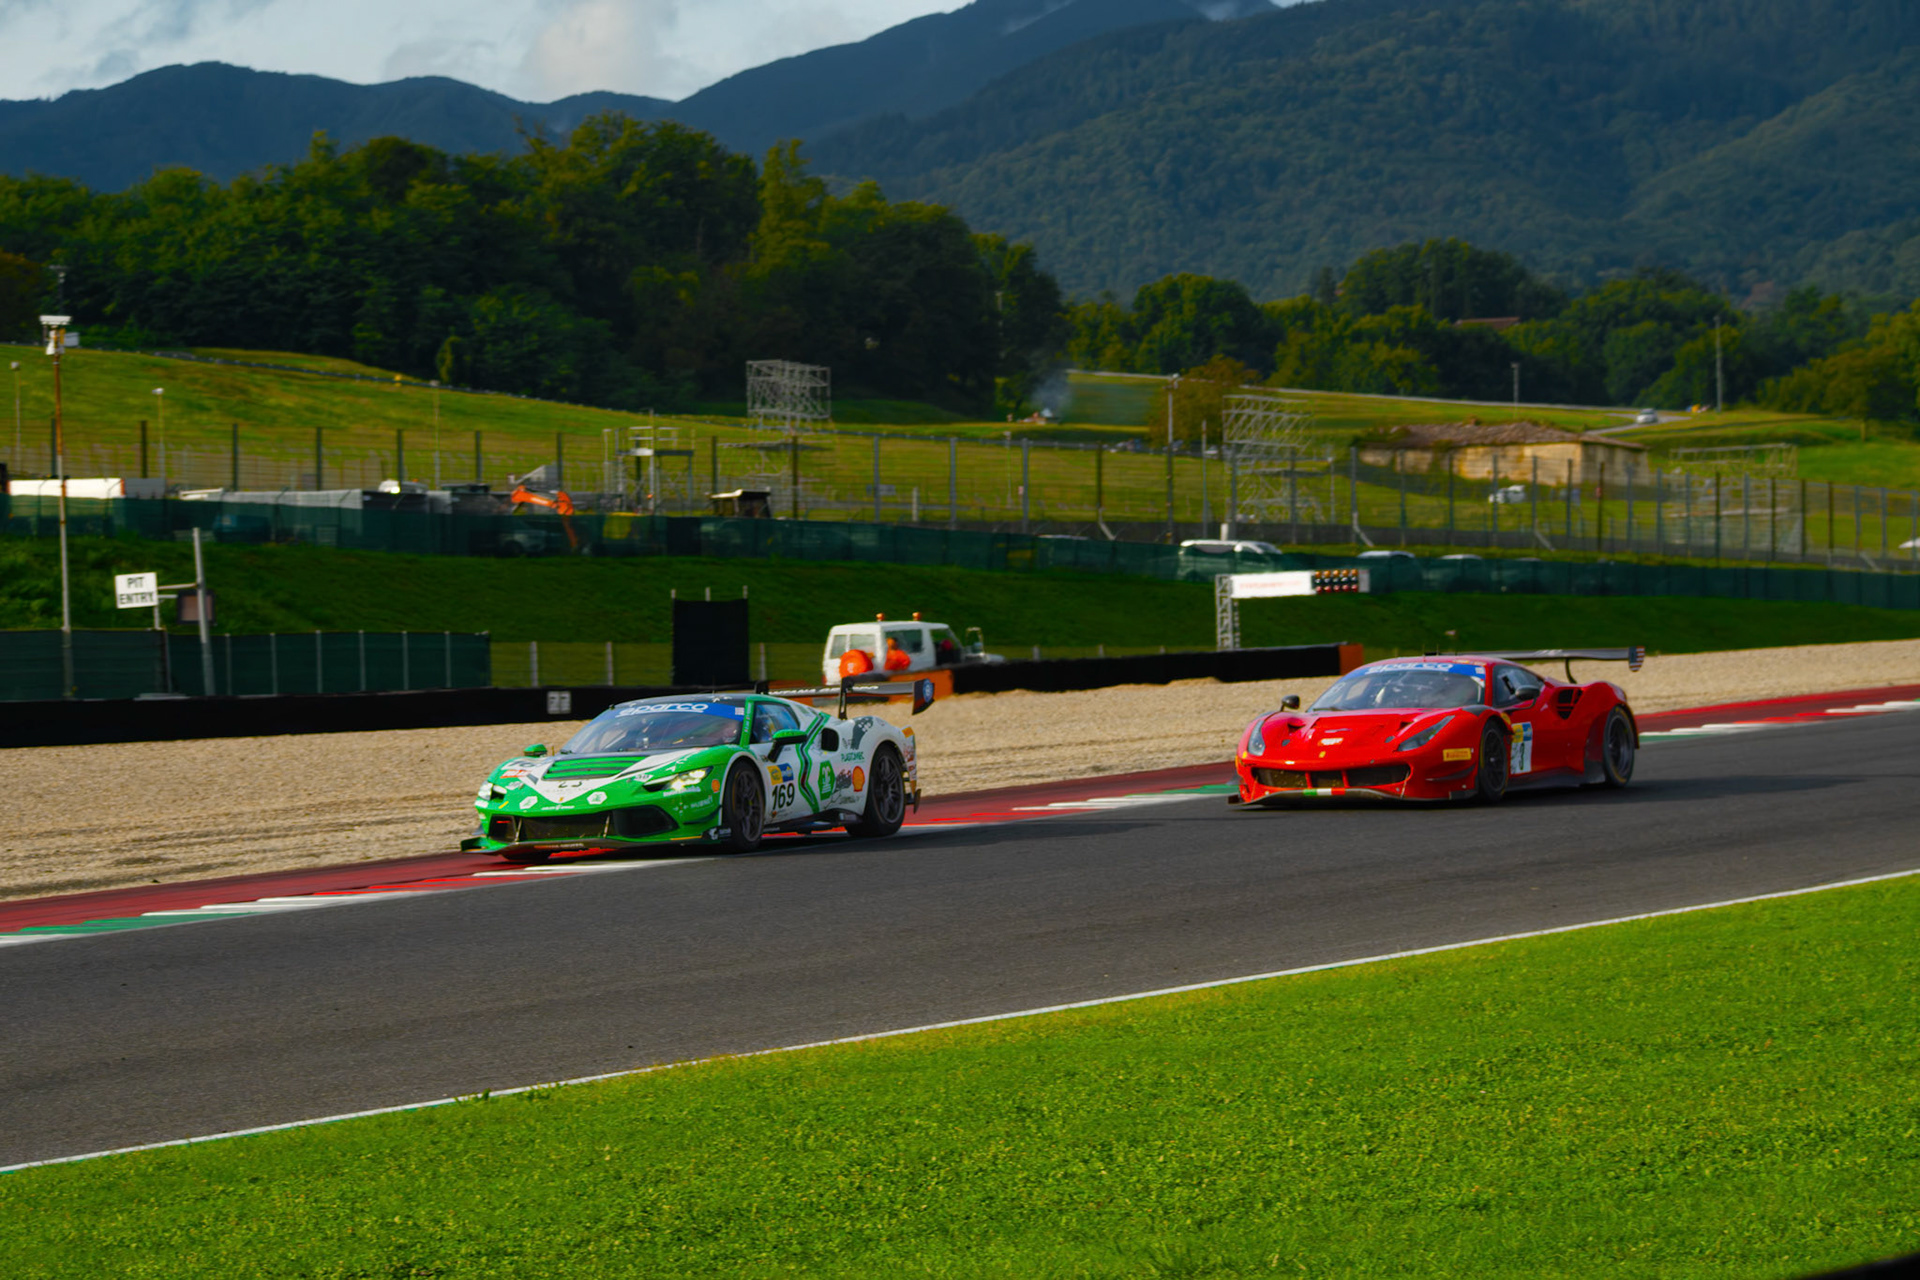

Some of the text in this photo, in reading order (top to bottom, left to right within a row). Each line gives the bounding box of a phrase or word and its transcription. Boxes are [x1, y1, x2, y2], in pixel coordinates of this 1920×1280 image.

[127, 577, 144, 588] PIT
[119, 593, 154, 604] ENTRY
[1365, 663, 1453, 675] sparco
[615, 703, 708, 718] sparco
[772, 783, 795, 810] 169
